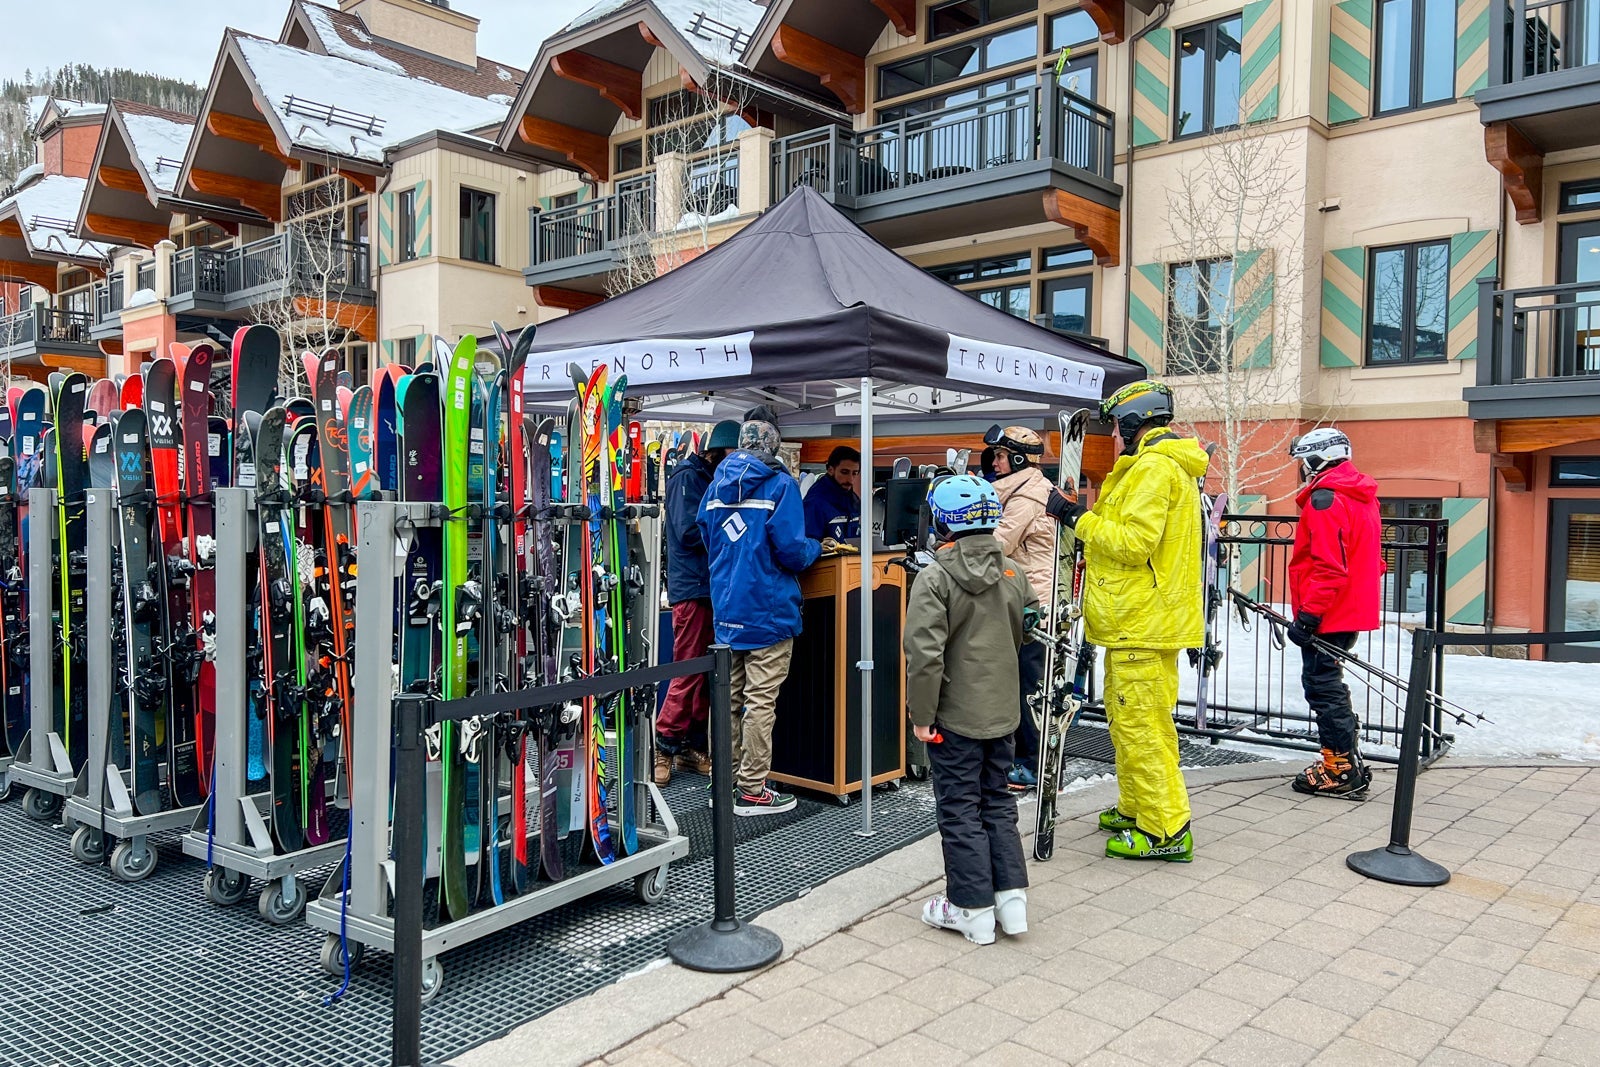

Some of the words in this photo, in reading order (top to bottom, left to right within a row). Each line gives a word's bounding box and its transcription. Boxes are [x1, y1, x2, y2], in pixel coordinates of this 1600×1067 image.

[525, 344, 739, 381] RUENORTH
[959, 348, 1099, 387] TRUENORTH
[195, 440, 204, 494] BLIZZARD
[1140, 847, 1186, 857] LANGE
